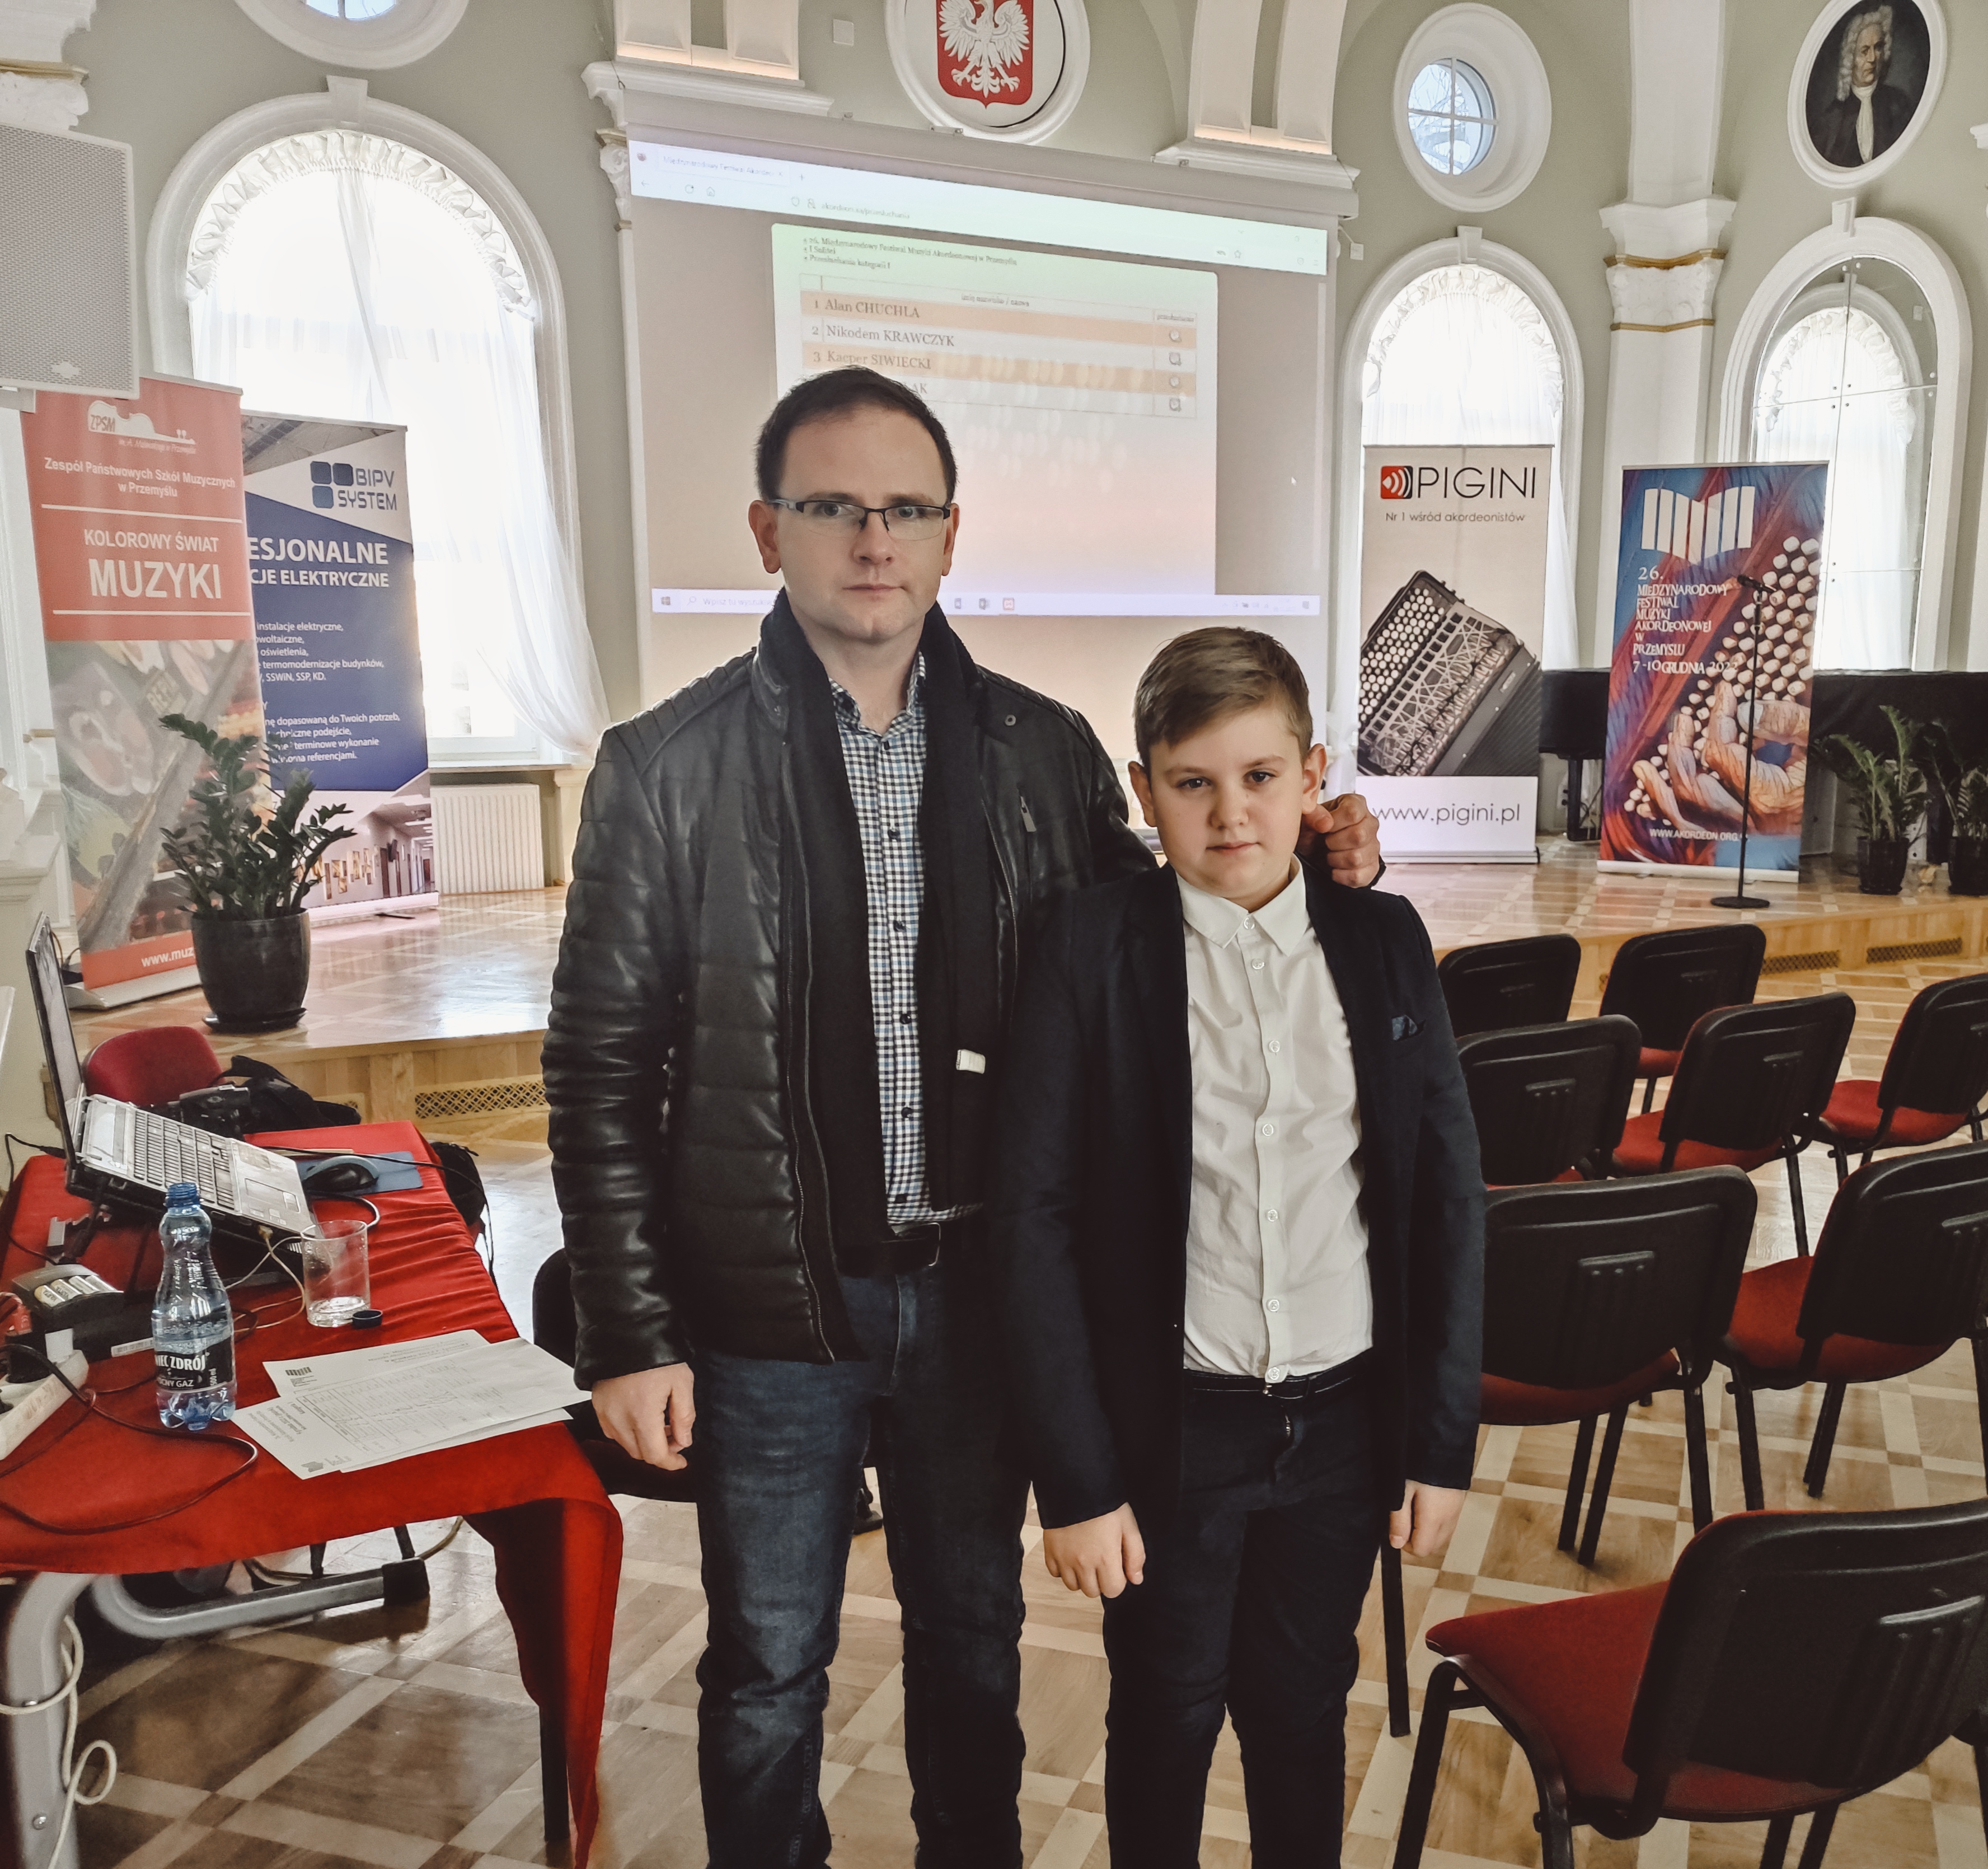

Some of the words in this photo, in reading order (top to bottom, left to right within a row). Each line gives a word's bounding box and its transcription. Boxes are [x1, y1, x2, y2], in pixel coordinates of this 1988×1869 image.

[825, 298, 852, 312] Alan
[812, 326, 819, 335] 2
[826, 324, 880, 340] Nikodem
[883, 330, 955, 346] KRAWCZYK
[813, 352, 820, 362] 3
[827, 350, 868, 365] Kacper
[871, 354, 931, 369] SIWIECKI
[44, 457, 83, 474] Zespół
[86, 461, 153, 481] Państwowych
[155, 469, 180, 483] Szkół
[183, 471, 236, 489] Muzycznych
[355, 468, 395, 488] BIPV
[1418, 467, 1536, 498] PIGINI
[118, 483, 126, 493] w
[128, 482, 178, 498] Przemyślu
[337, 490, 397, 510] SYSTEM
[1385, 512, 1398, 521] Nr
[1410, 511, 1441, 522] wśród
[1445, 512, 1526, 522] akordeonistów
[84, 528, 171, 550] KOLOROWY
[175, 531, 219, 552] ŚWIAT
[88, 558, 222, 599] MUZYKI
[280, 569, 390, 587] ELEKTRYCZNE
[1638, 566, 1664, 580] 26.
[1637, 596, 1680, 608] FESTIWAL
[1635, 608, 1671, 620] MUZYKI
[257, 621, 296, 633] instalacje
[297, 621, 344, 633] elektryczne,
[1635, 620, 1712, 633] AKORDEONOWEJ
[1635, 632, 1645, 641] W
[260, 647, 309, 657] oświetlenia,
[262, 659, 341, 669] termomodernizacje
[342, 659, 385, 670] budynków,
[1662, 661, 1706, 674] GRUDNIA
[1709, 661, 1739, 673] 2022
[296, 672, 312, 681] SSP,
[312, 672, 326, 681] KD.
[276, 715, 328, 727] dopasowaną
[329, 714, 340, 724] do
[340, 714, 368, 723] Twoich
[369, 712, 401, 723] potrzeb,
[313, 727, 352, 738] podejście,
[294, 739, 337, 750] terminowe
[338, 737, 380, 749] wykonanie
[307, 751, 357, 762] referencjami.
[1372, 803, 1520, 825] www.pigini.pl
[170, 1354, 206, 1371] ZDRÓJ
[176, 1379, 194, 1388] GAZ
[209, 1375, 217, 1386] 500
